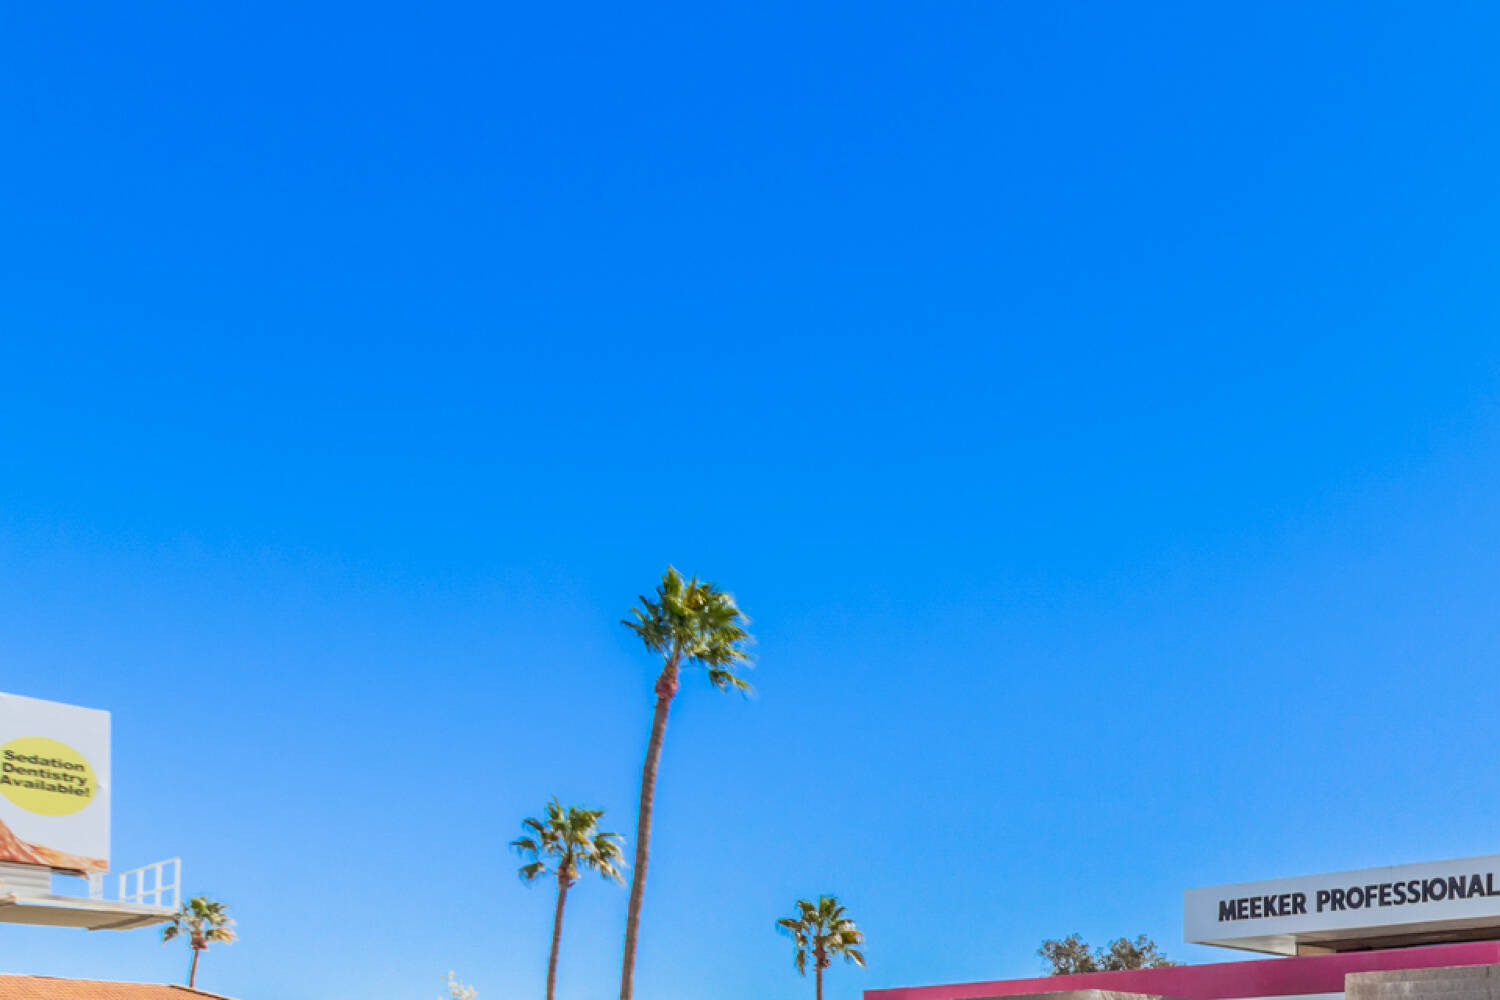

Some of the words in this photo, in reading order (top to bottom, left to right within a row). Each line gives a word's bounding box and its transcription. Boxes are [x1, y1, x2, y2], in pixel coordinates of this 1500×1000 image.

[3, 749, 85, 772] Sedation
[2, 762, 88, 786] Dentistry
[0, 775, 90, 798] Available!
[1218, 892, 1307, 922] MEEKER
[1316, 872, 1500, 913] PROFESSIONAL
